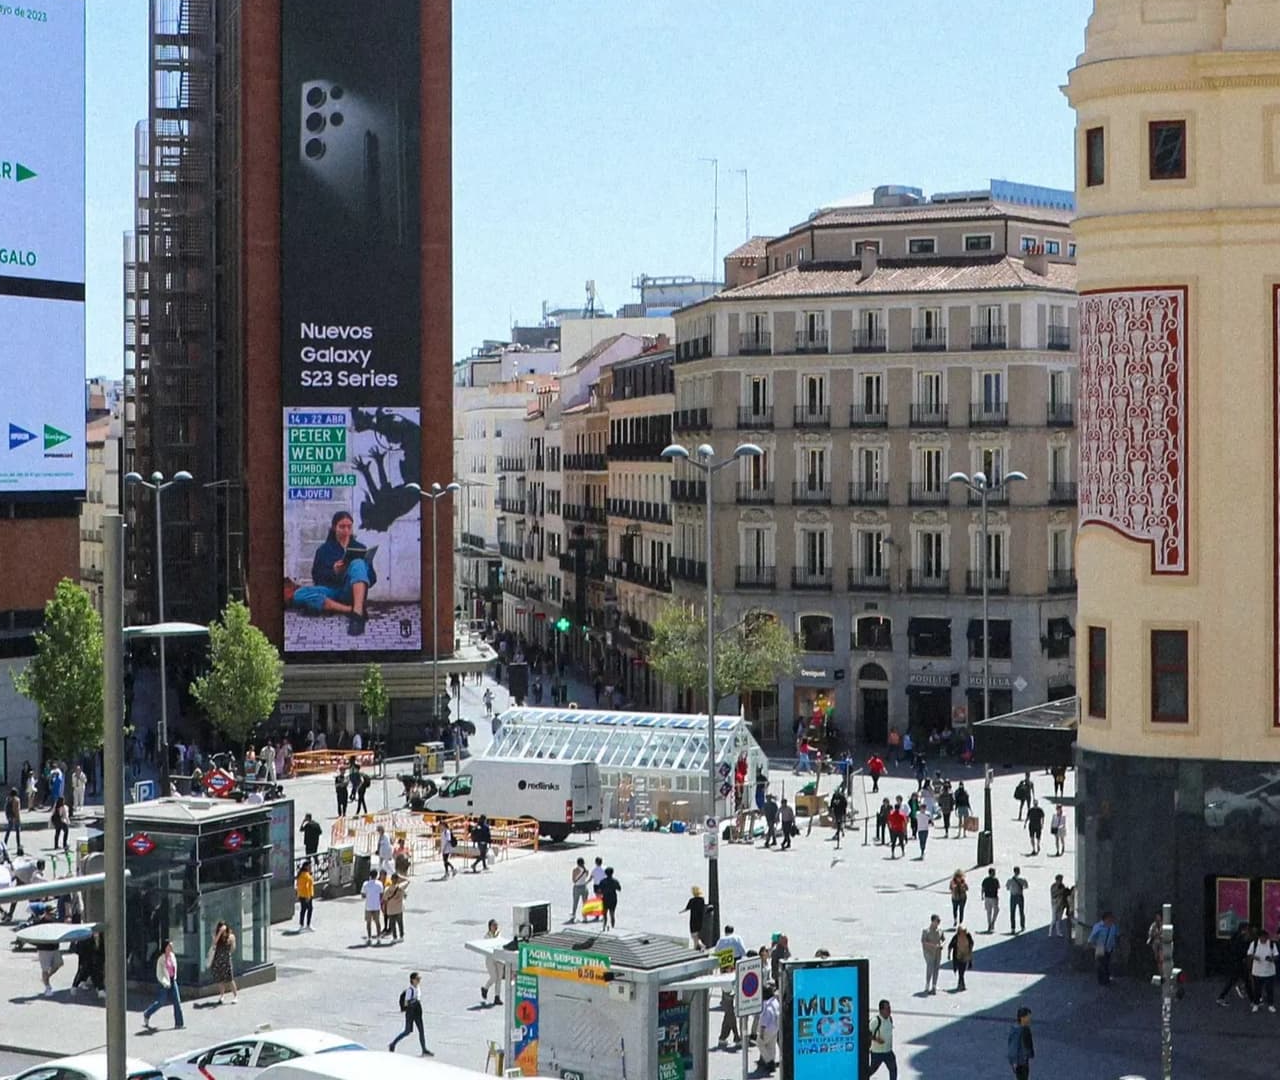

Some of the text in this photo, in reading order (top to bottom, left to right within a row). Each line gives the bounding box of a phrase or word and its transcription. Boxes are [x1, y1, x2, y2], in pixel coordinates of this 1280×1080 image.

[14, 6, 25, 18] de
[26, 9, 48, 22] 2023
[300, 322, 373, 339] Nuevos
[300, 346, 372, 368] Galaxy
[300, 369, 399, 387] S23 Series
[291, 414, 345, 424] 14 22 ABR
[290, 428, 344, 442] PETER Y
[291, 446, 343, 461] WENDY
[290, 463, 332, 473] RUMBO A
[290, 474, 355, 485] NUNCA JAMÁS
[290, 489, 331, 499] LAJOVEN
[141, 785, 150, 802] P
[798, 993, 853, 1017] MUS
